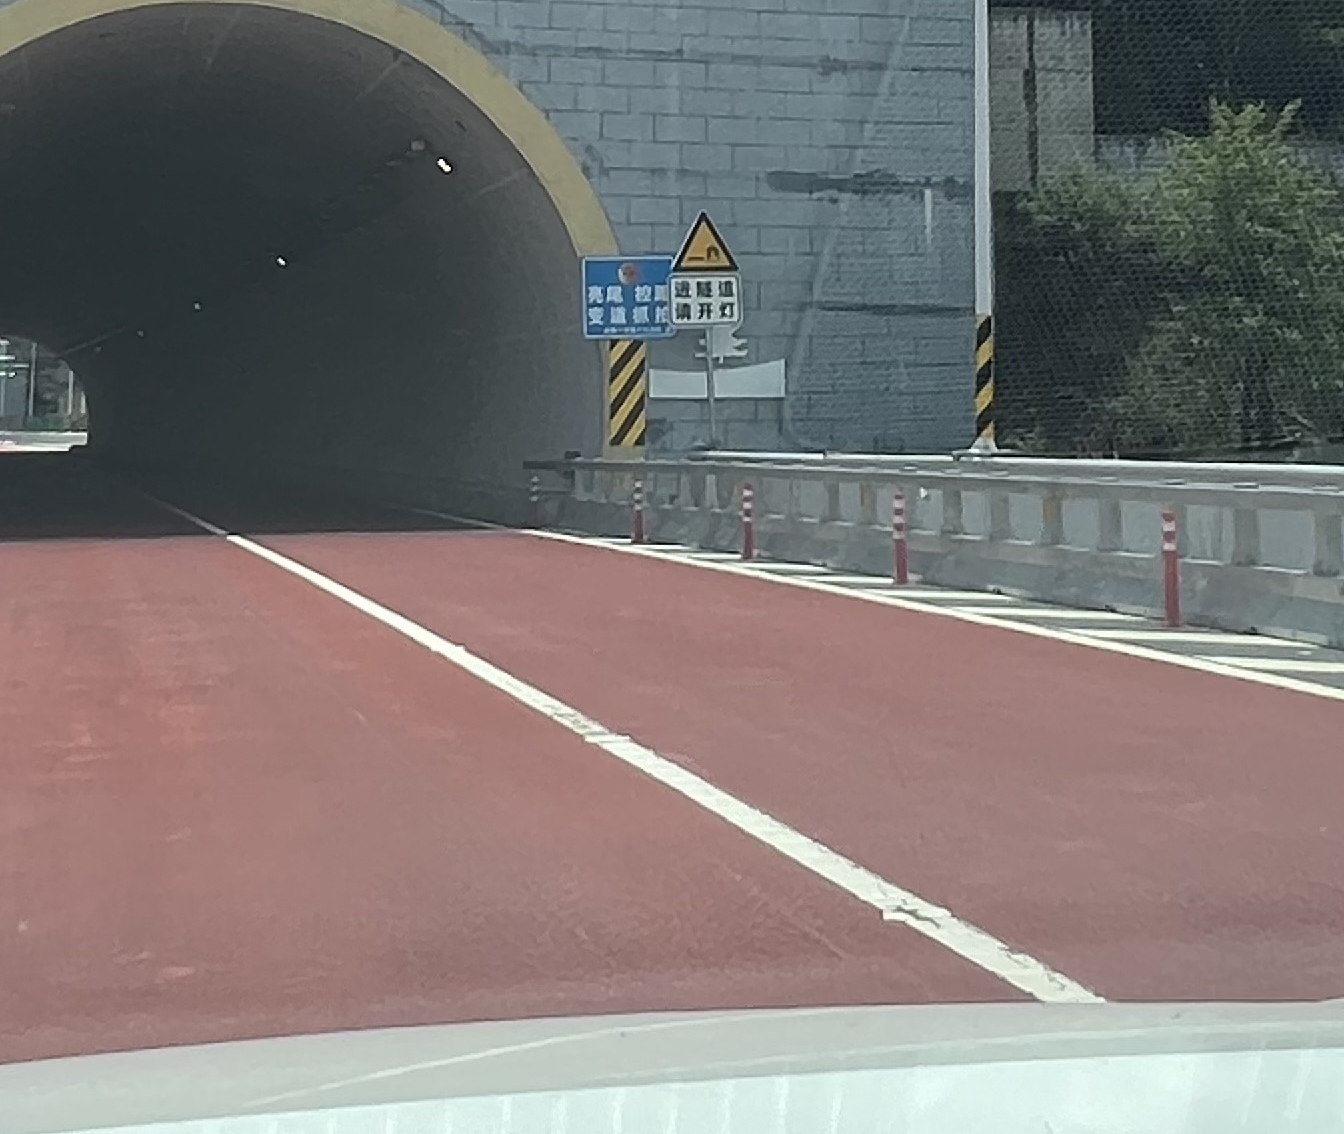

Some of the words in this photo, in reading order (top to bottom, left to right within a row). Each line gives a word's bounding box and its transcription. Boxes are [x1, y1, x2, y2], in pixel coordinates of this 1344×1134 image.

[674, 280, 735, 298] 进隧道
[675, 302, 735, 320] 请开灯
